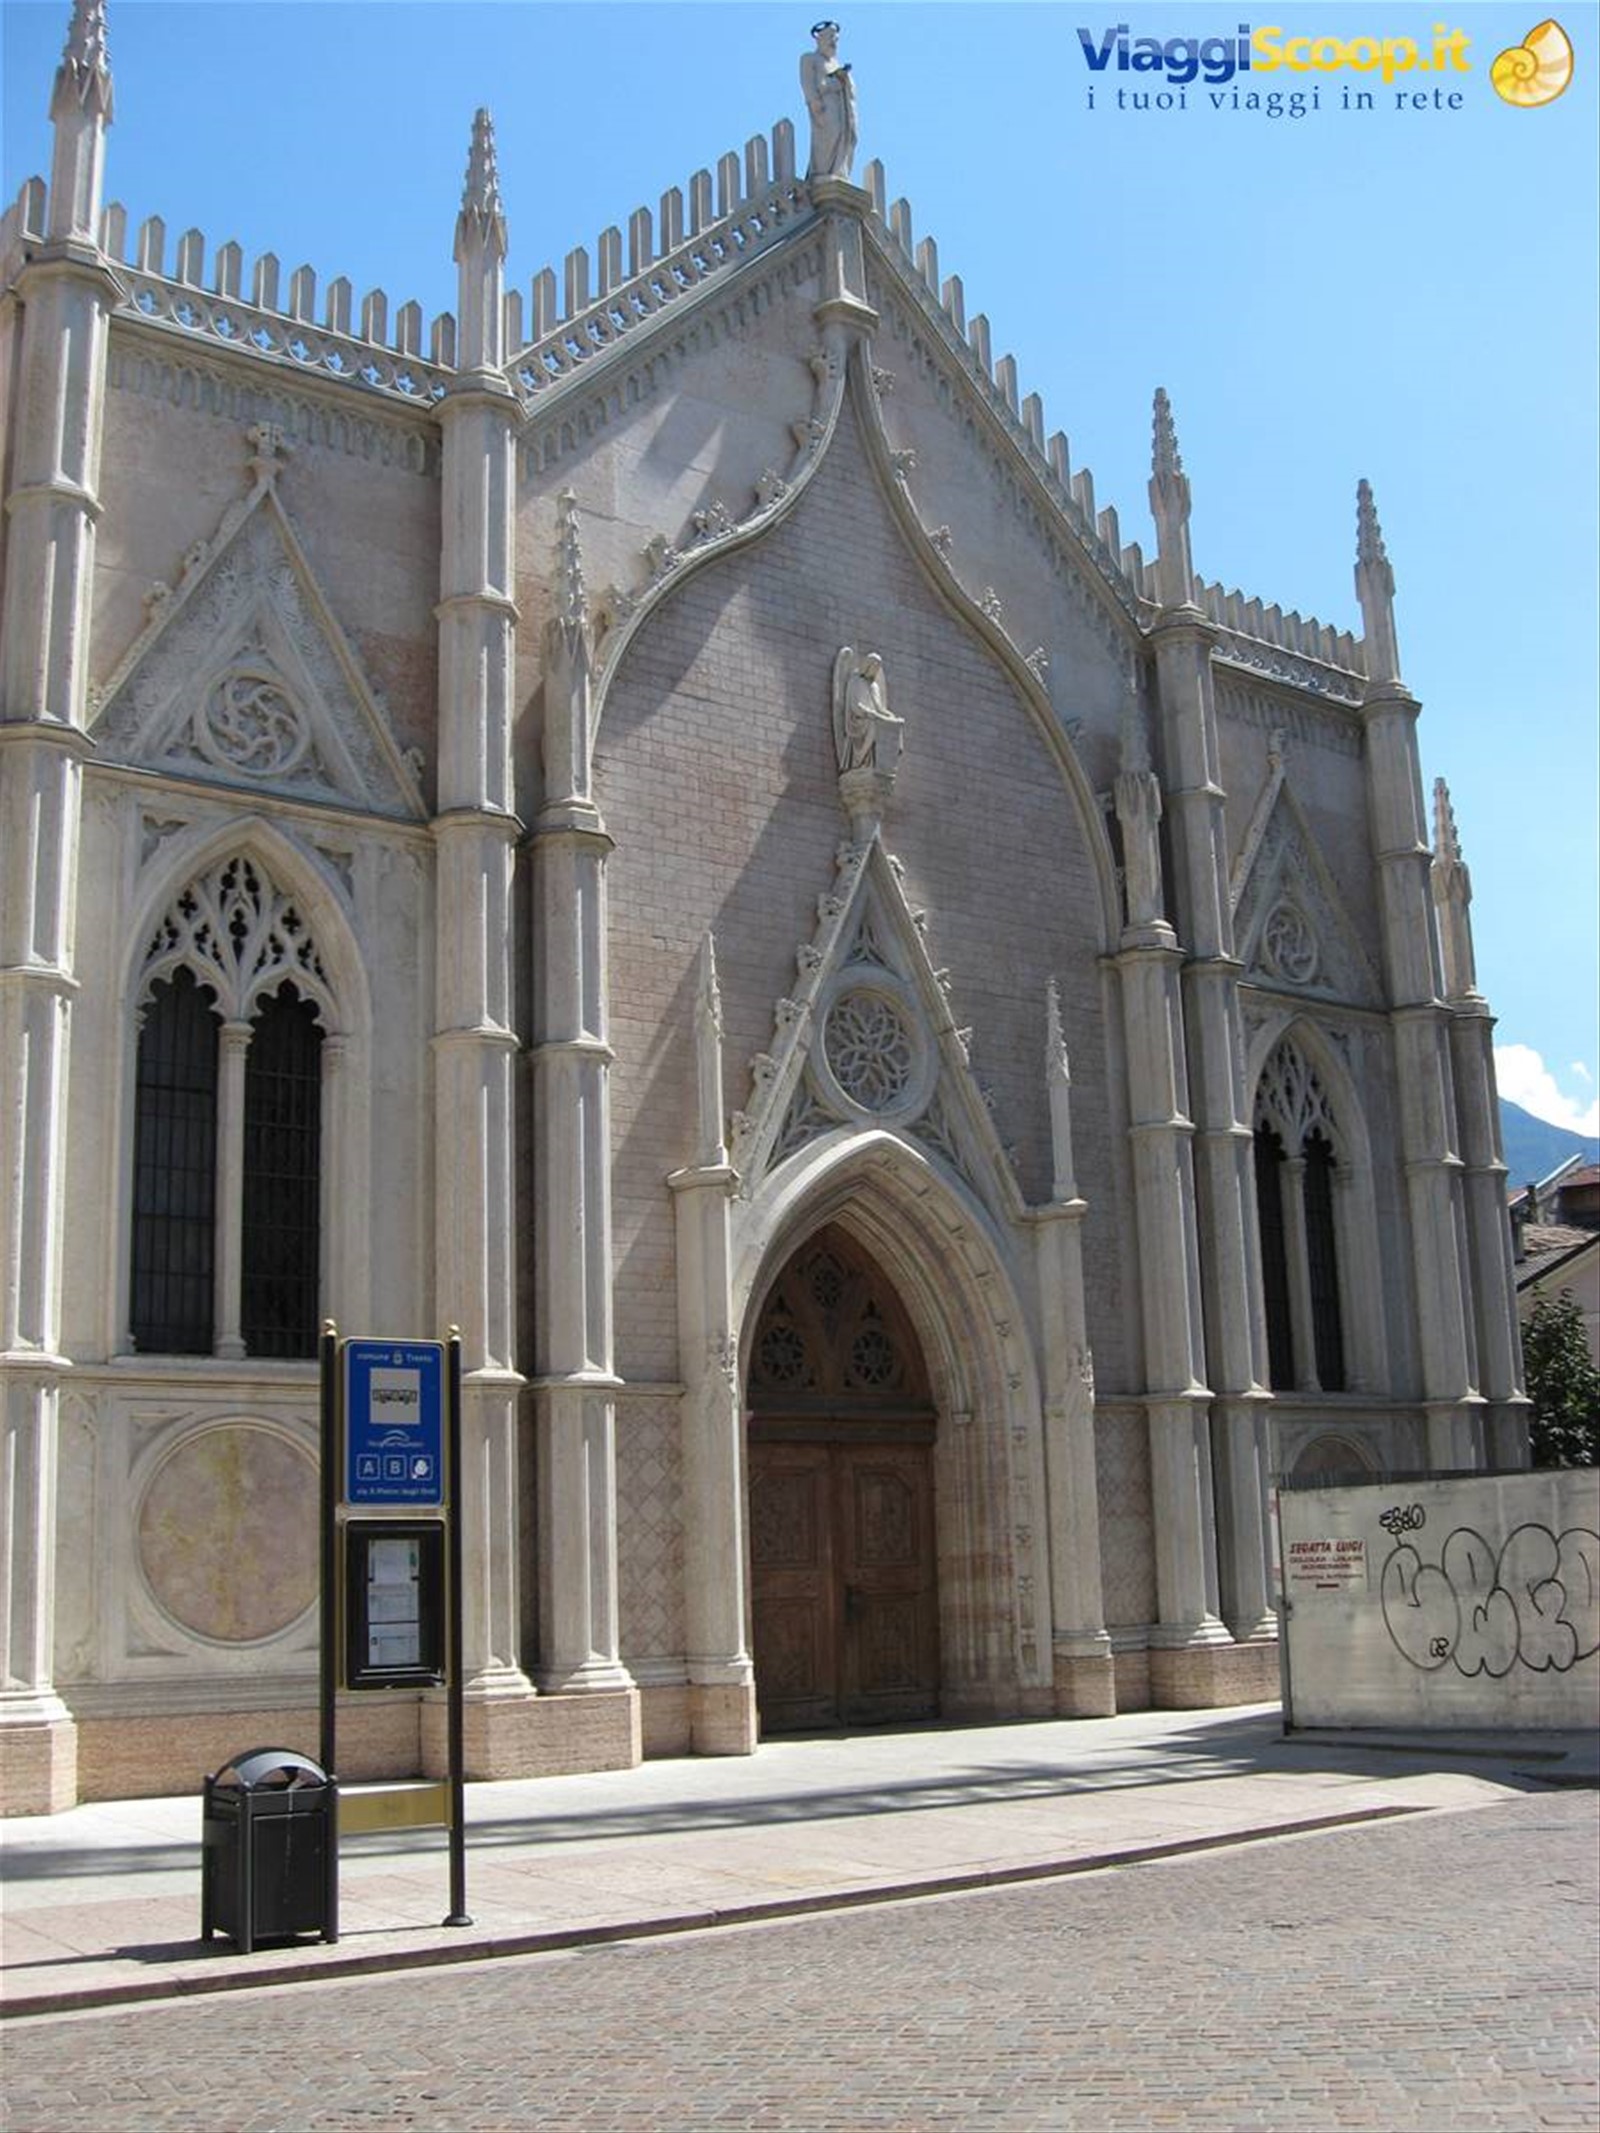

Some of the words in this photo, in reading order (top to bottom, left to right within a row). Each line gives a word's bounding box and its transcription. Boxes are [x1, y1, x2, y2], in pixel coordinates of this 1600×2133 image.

[363, 1460, 375, 1475] A
[390, 1460, 401, 1475] B
[1336, 1540, 1364, 1553] LUIGI
